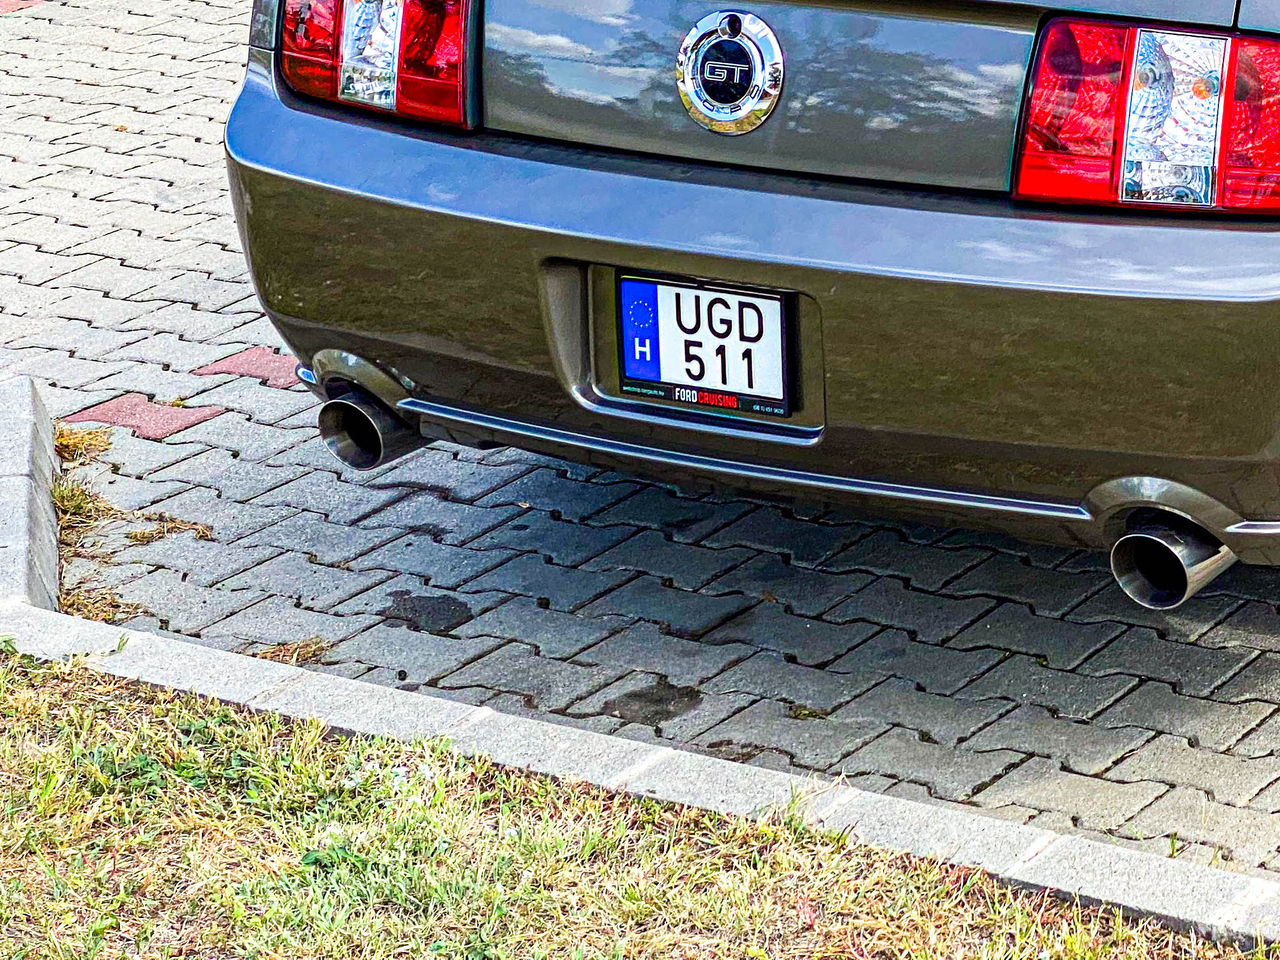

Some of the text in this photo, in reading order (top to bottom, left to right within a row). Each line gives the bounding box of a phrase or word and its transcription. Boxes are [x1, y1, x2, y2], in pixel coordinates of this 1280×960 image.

[703, 60, 750, 84] GT
[675, 292, 764, 343] UGD
[634, 337, 754, 389] H 511
